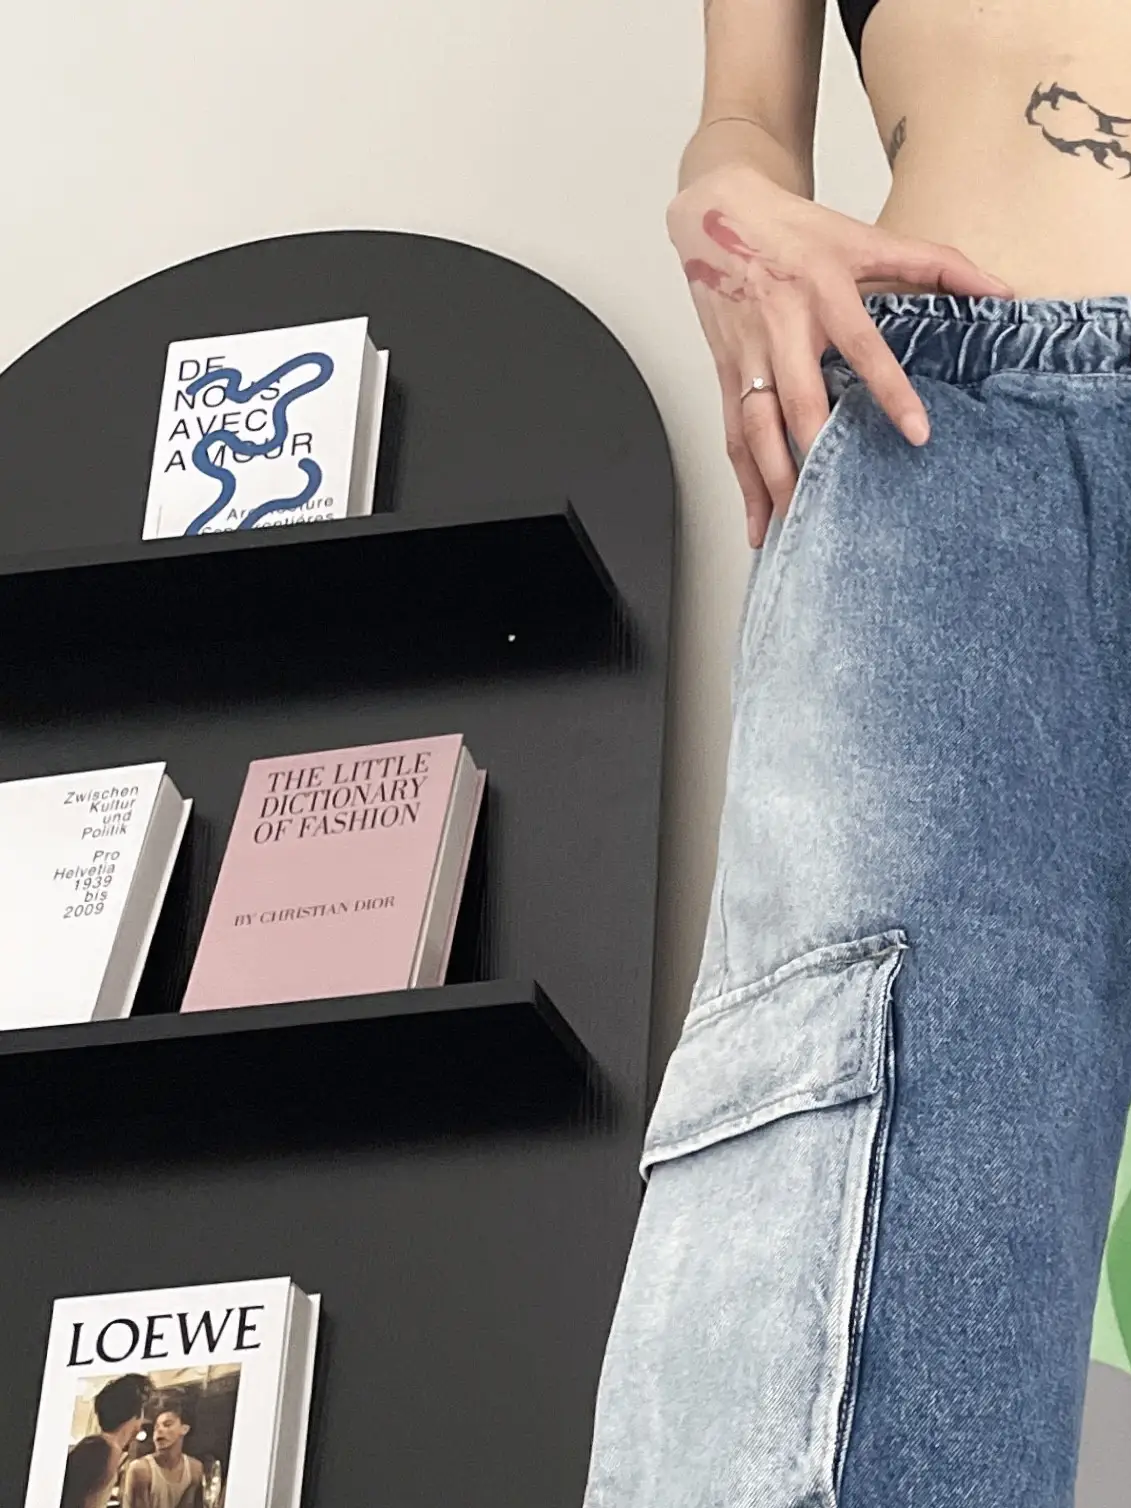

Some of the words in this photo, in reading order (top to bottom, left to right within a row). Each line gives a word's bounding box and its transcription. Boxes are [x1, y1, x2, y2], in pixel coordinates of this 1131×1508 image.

[173, 378, 281, 412] NOS
[168, 408, 268, 442] AVEC
[268, 766, 325, 793] THE
[333, 752, 431, 785] LITTLE
[63, 785, 139, 805] Zwischen
[259, 776, 428, 819] DICTIONARY
[89, 798, 137, 814] Kultur
[102, 809, 132, 825] und
[254, 819, 293, 844] OF
[297, 802, 421, 838] FASHION
[81, 824, 128, 840] Politik
[92, 849, 120, 863] Pro
[53, 862, 116, 881] Helvetia
[74, 874, 113, 891] 1939
[84, 890, 108, 903] bis
[62, 901, 105, 920] 2009
[234, 913, 256, 927] BY
[259, 902, 349, 924] CHRISTIAN
[354, 895, 396, 912] DIOR
[66, 1305, 265, 1367] LOEWE
